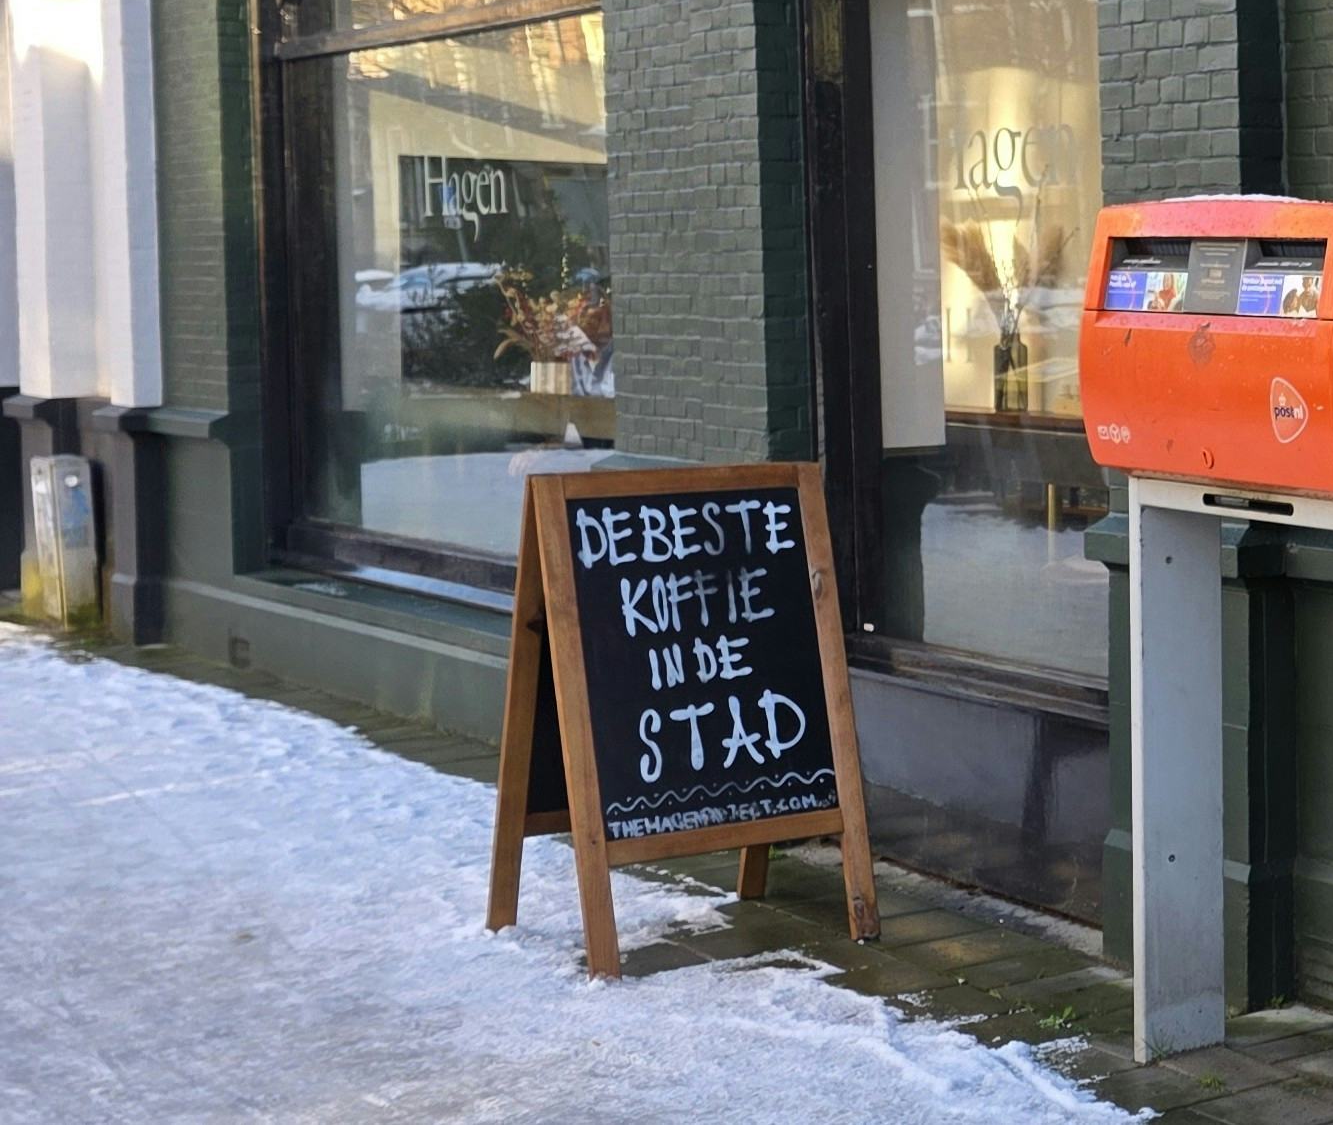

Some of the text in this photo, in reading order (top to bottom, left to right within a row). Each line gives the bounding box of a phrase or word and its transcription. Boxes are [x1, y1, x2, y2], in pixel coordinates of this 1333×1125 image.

[423, 154, 508, 243] Hagen
[620, 566, 775, 637] KOFFIE
[649, 634, 753, 691] IN DE
[639, 689, 806, 783] STAD
